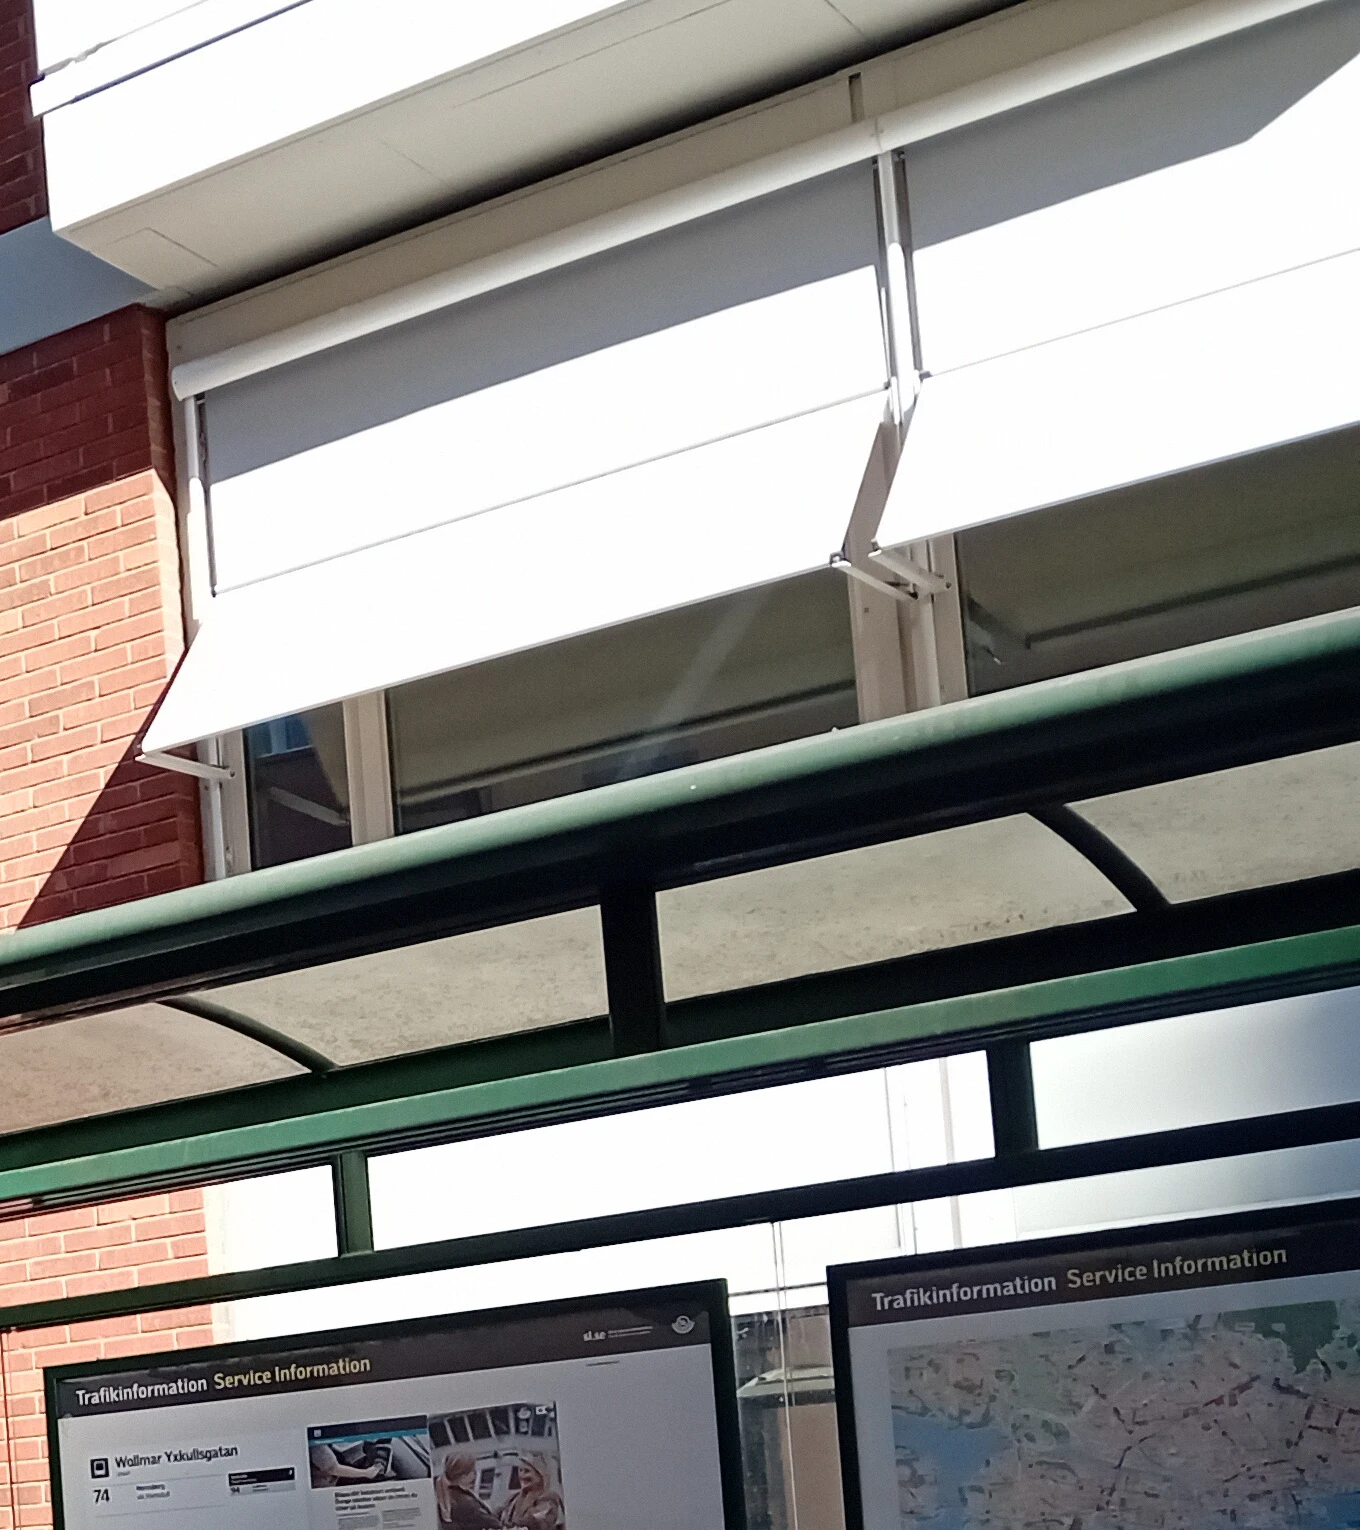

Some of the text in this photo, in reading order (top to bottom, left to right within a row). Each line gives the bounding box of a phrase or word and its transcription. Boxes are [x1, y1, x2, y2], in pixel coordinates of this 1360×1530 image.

[872, 1248, 1288, 1311] Trafikinformation Service Information
[76, 1356, 371, 1406] Trafikinformation Service Information
[93, 1488, 110, 1504] 74
